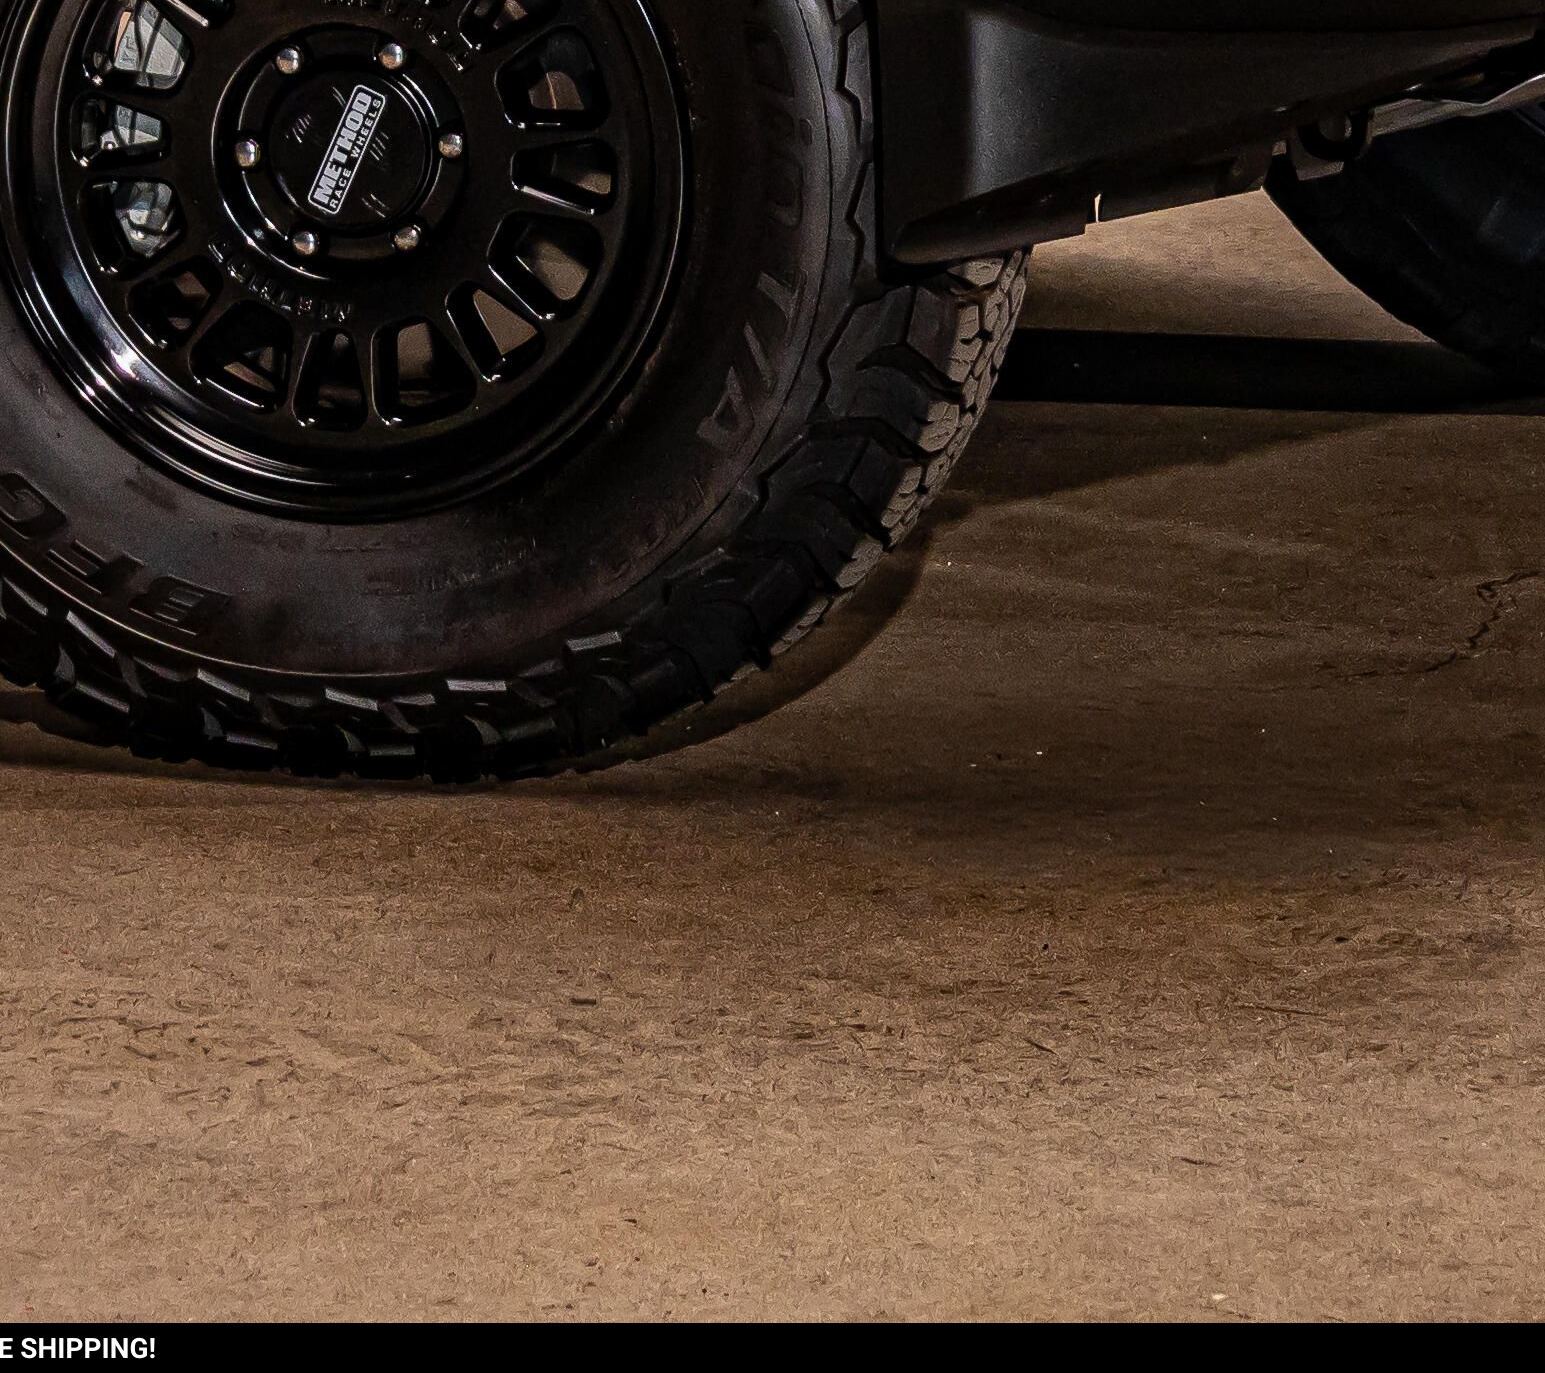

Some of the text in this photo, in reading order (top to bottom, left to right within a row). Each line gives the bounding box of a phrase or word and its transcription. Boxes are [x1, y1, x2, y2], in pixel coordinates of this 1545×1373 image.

[313, 91, 372, 205] METHOD
[330, 98, 382, 209] RACE WHEELS
